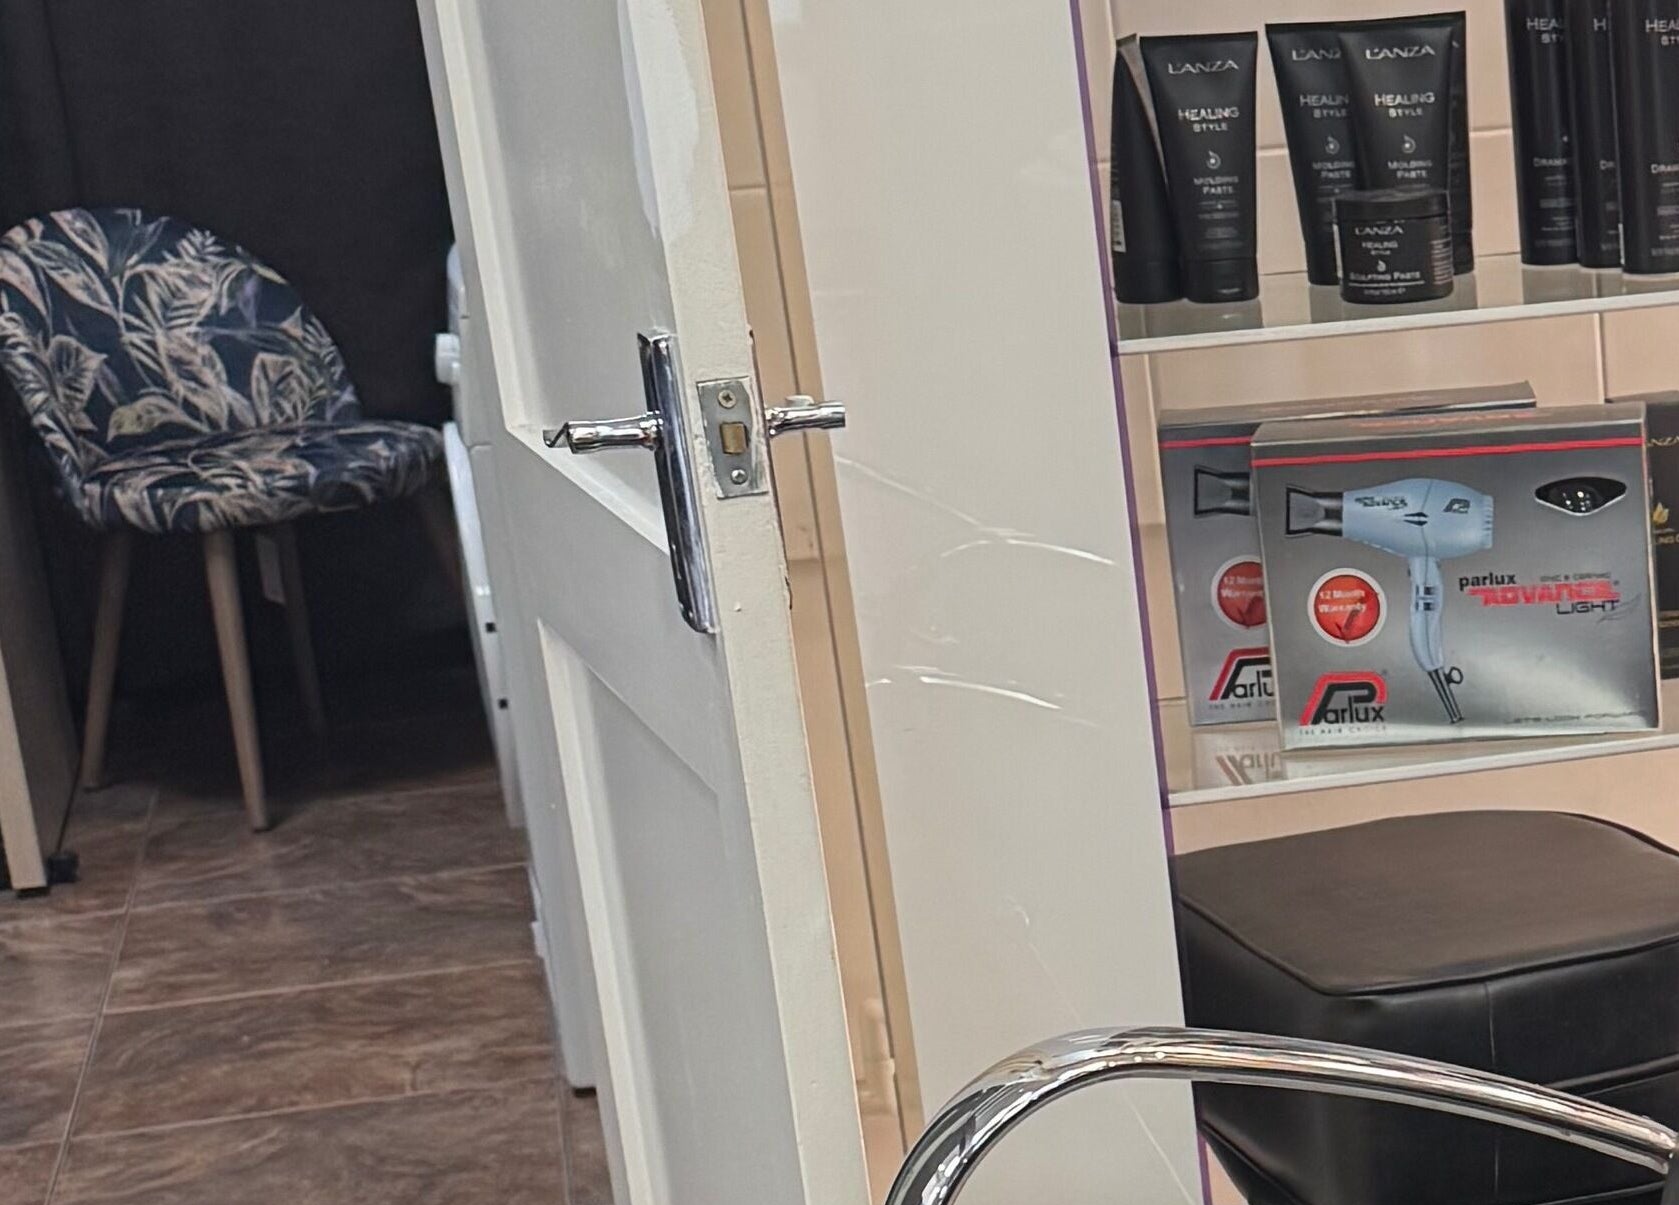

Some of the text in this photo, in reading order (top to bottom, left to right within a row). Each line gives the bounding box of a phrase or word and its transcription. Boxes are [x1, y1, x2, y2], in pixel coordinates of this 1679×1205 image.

[1300, 93, 1349, 107] HEALIN
[1374, 92, 1436, 107] HEALING
[1178, 107, 1239, 122] HEALING
[1388, 107, 1424, 118] STYLE
[1193, 122, 1229, 133] STYLE
[1236, 576, 1263, 585] Mont
[1458, 572, 1517, 591] parlux
[1332, 589, 1366, 599] Month
[1555, 599, 1620, 615] LIGHT
[1209, 647, 1274, 701] Parlu
[1300, 670, 1388, 726] Parlux
